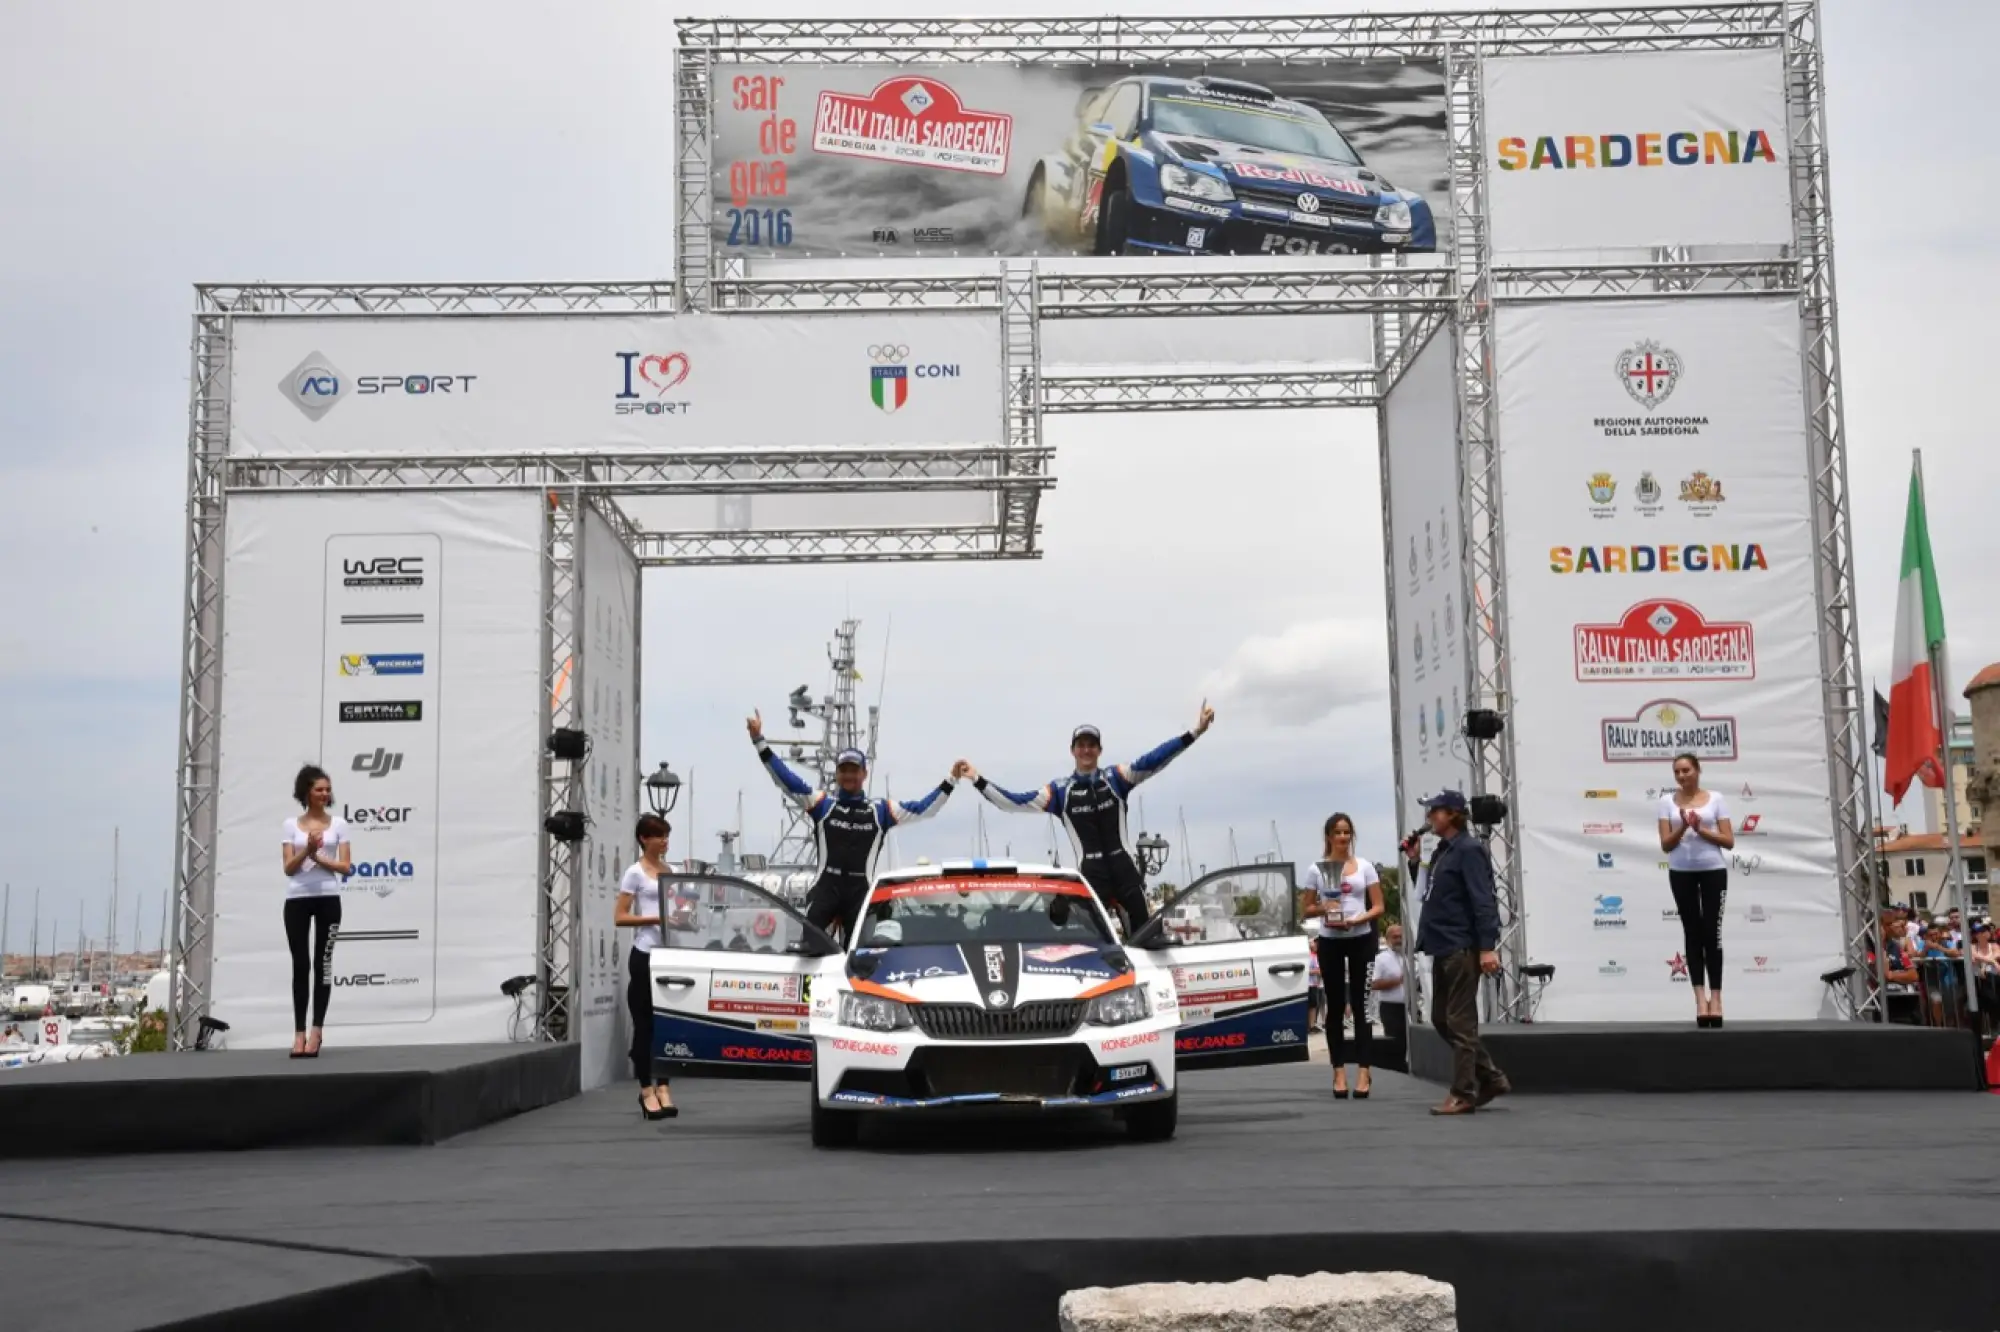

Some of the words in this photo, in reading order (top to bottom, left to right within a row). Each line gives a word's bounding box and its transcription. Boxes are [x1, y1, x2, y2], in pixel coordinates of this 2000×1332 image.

[732, 75, 785, 111] sar
[759, 112, 796, 155] de
[819, 96, 867, 136] RALLY
[869, 114, 918, 145] ITALIA
[922, 119, 1005, 156] SARDEGNA
[1498, 129, 1776, 171] SARDEGNA
[730, 160, 788, 208] gna
[1233, 163, 1302, 184] Red
[1304, 171, 1367, 196] Bull
[726, 208, 793, 247] 2016
[872, 230, 896, 243] FIA
[1261, 233, 1348, 256] POLO
[615, 351, 640, 399] I
[873, 367, 904, 378] ITALIA
[915, 364, 960, 378] CONI
[300, 376, 339, 396] ACI
[357, 375, 477, 395] SPORT
[615, 401, 692, 415] SPORT
[1593, 417, 1642, 427] REGIONE
[1644, 416, 1709, 426] AUTONOMA
[1604, 427, 1637, 437] DELLA
[1640, 426, 1700, 436] SARDEGNA
[1550, 543, 1768, 574] SARDEGNA
[1579, 629, 1620, 663] RALLY
[1624, 636, 1670, 663] ITALIA
[1673, 627, 1749, 663] SARDEGNA
[343, 705, 404, 714] CERTINA
[1607, 723, 1638, 748] RALLY
[1641, 728, 1673, 746] DELLA
[1675, 723, 1731, 746] SARDEGNA
[344, 804, 412, 824] Lexar
[714, 979, 781, 991] SARDEGNA
[1188, 968, 1251, 982] SARDEGNA
[832, 1039, 898, 1056] KONECRANES
[1175, 1033, 1246, 1050] NECRANES
[722, 1047, 813, 1062] KONECRANES
